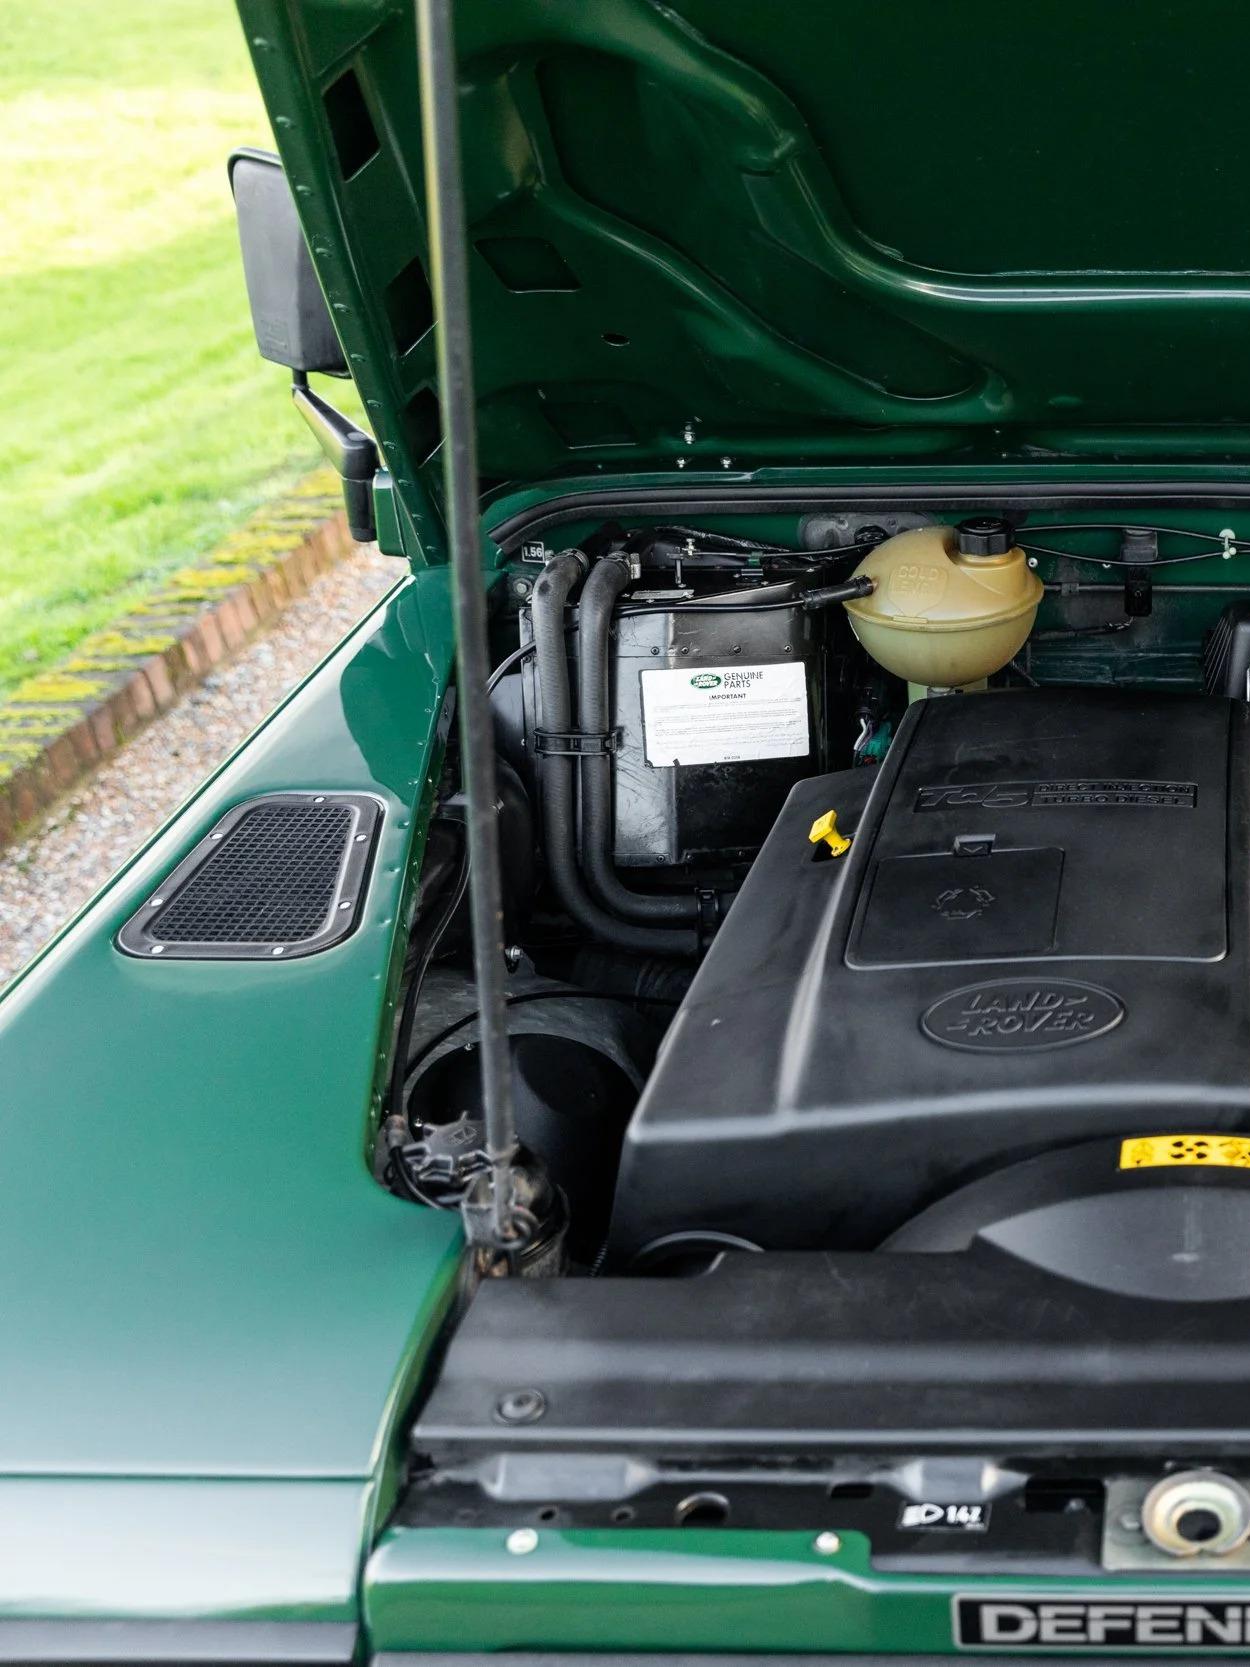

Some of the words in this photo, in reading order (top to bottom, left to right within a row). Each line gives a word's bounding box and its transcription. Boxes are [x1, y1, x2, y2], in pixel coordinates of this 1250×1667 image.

[523, 546, 542, 557] 1.56
[724, 671, 763, 680] GENUINE
[724, 680, 751, 688] PARTS
[1038, 783, 1100, 792] DIRECT
[1103, 783, 1190, 793] INJECTION
[1040, 794, 1109, 804] TURBO
[1115, 794, 1188, 805] DIESEL
[961, 991, 1064, 1015] LAND
[968, 1010, 1095, 1036] ROVER
